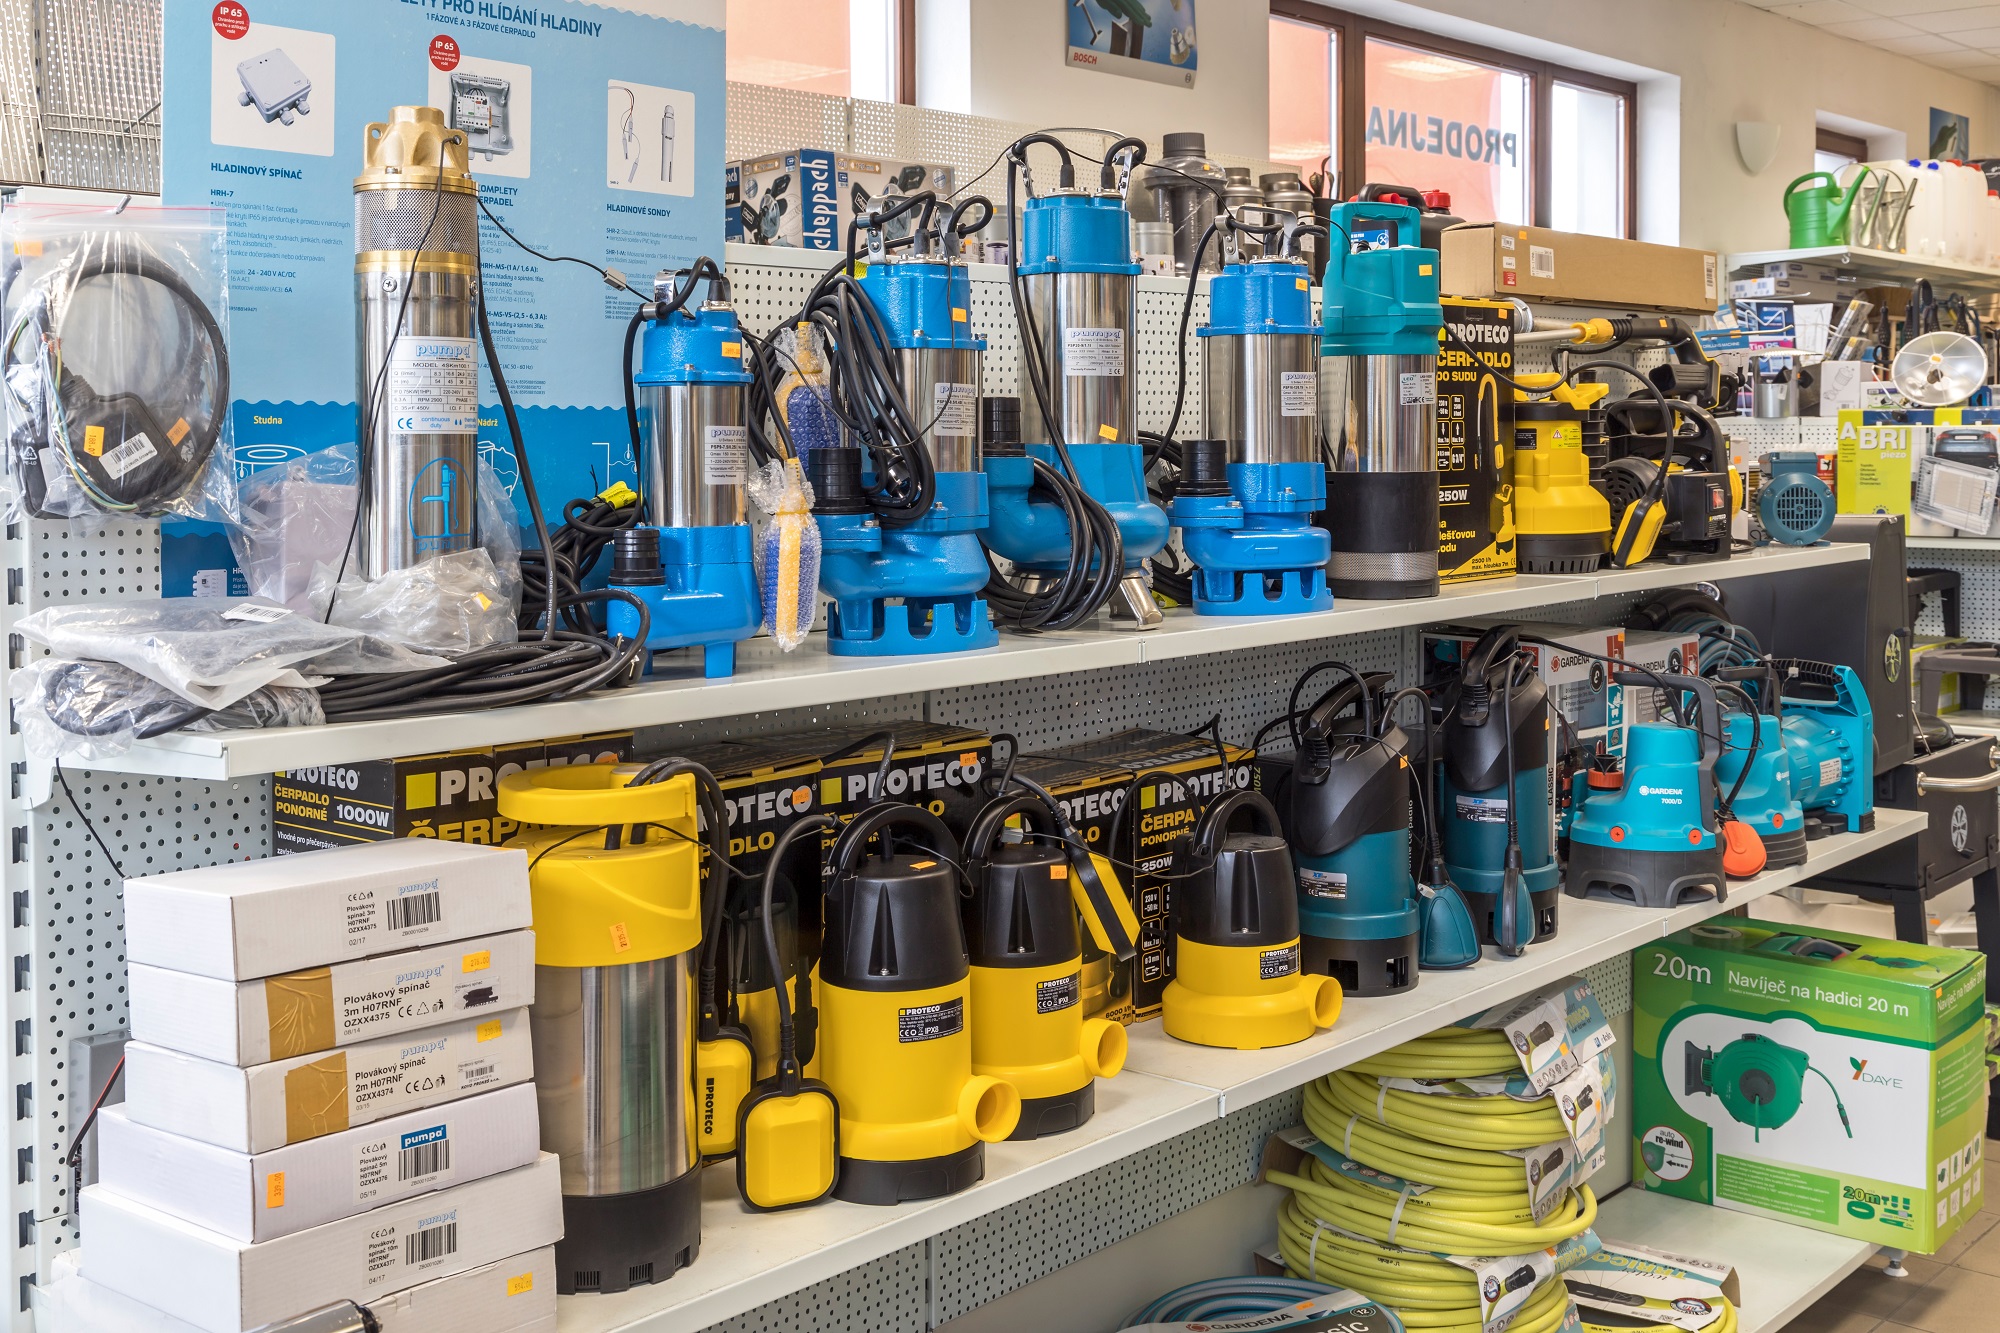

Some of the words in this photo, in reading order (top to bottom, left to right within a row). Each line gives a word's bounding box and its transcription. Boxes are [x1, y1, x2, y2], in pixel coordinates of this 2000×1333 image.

[220, 6, 229, 15] IP
[231, 8, 242, 17] 65
[426, 12, 431, 21] 1
[431, 12, 459, 26] FÁZOVÉ
[459, 19, 466, 27] A
[472, 20, 499, 32] FÁZOVÉ
[500, 25, 536, 39] ČERPADLO
[443, 0, 475, 14] PRO
[478, 2, 538, 27] HLÍDÁNÍ
[541, 13, 603, 38] HLADINY
[435, 40, 443, 48] IP
[444, 42, 454, 50] 65
[1073, 52, 1098, 65] BOSCH
[211, 162, 267, 179] HLADINOVÝ
[269, 168, 303, 180] SPÍNAČ
[210, 189, 234, 198] HRH-7
[479, 184, 518, 196] OMPLETY
[606, 203, 646, 215] HLADINOVÉ
[647, 207, 671, 217] SONDY
[800, 157, 837, 250] cheppach
[1448, 323, 1508, 345] PROTECO
[416, 343, 471, 357] pumpa
[1452, 371, 1477, 383] SUDU
[253, 415, 283, 425] Studna
[477, 417, 499, 427] Nádrž
[1880, 450, 1907, 460] piezo
[1438, 489, 1468, 502] 250W
[1560, 653, 1590, 669] GARDENA
[283, 765, 360, 791] PROTECO
[274, 781, 330, 806] ČERPADLO
[1649, 787, 1683, 796] GARDENA
[1661, 797, 1683, 805] 7000/D
[276, 801, 328, 822] PONORNÉ
[335, 803, 390, 828] 1000W
[277, 831, 298, 844] Vhodné
[297, 836, 307, 845] pro
[1141, 855, 1173, 875] 250W
[398, 879, 439, 896] pumpa
[1144, 895, 1153, 903] 230
[346, 902, 376, 912] Plovákový
[347, 911, 366, 921] spínač
[347, 917, 370, 927] H07RNF
[348, 924, 377, 934] OZXX4375
[348, 936, 366, 947] 02/17
[1265, 949, 1289, 957] PROTECO
[396, 965, 445, 986] pumpa
[1651, 952, 1712, 985] 20m
[1043, 977, 1071, 989] PROTECO
[344, 987, 395, 1006] Plovákový
[398, 980, 431, 995] spínač
[1727, 968, 1787, 996] Navíječ
[1790, 983, 1810, 999] na
[1814, 984, 1862, 1010] hadici
[1866, 997, 1888, 1014] 20
[1892, 1004, 1909, 1017] m
[1935, 993, 1956, 1014] Navíječ
[1955, 987, 1963, 1000] na
[1962, 977, 1976, 997] hadici
[344, 1007, 359, 1017] 3m
[362, 997, 403, 1014] H07RNF
[906, 1005, 941, 1016] PROTECO
[344, 1011, 390, 1029] OZXX4375
[343, 1027, 361, 1036] 08/14
[401, 1039, 447, 1059] pumpa
[355, 1063, 397, 1081] Plovákový
[399, 1057, 426, 1070] spínač
[355, 1083, 368, 1093] 2m
[370, 1073, 404, 1089] H07RNF
[1861, 1071, 1903, 1090] DAYE
[356, 1087, 394, 1104] OZXX4374
[704, 1084, 714, 1136] PROTECO
[404, 1127, 445, 1147] pumpa
[1658, 1129, 1676, 1139] auto
[1654, 1135, 1684, 1150] re-wind
[359, 1153, 388, 1165] Plovákový
[359, 1163, 378, 1173] spínač
[359, 1169, 381, 1180] H07RNF
[273, 1172, 282, 1197] 339.00
[359, 1174, 388, 1187] OZXX4376
[359, 1189, 377, 1199] 05/19
[1842, 1185, 1881, 1206] 20m
[417, 1209, 457, 1230] pumpa
[368, 1238, 396, 1251] Plovákový
[369, 1247, 387, 1259] spínač
[387, 1244, 399, 1252] 10m
[368, 1254, 390, 1265] H07RNF
[368, 1259, 396, 1273] OZXX4377
[369, 1274, 386, 1286] 04/17
[1210, 1312, 1293, 1331] GARDENA
